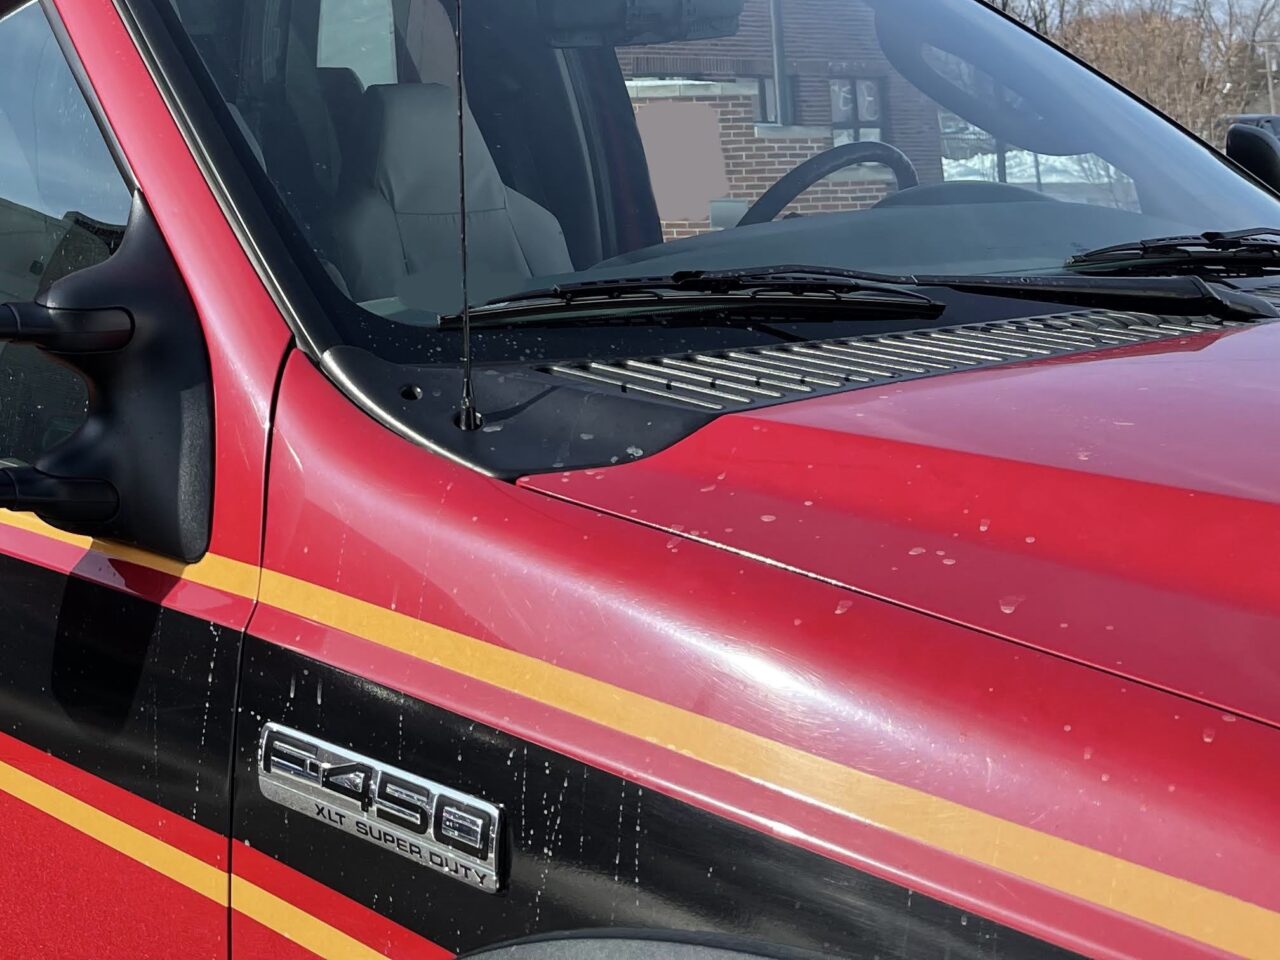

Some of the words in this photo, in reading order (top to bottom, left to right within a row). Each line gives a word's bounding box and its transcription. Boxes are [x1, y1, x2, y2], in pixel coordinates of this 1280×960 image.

[263, 728, 492, 861] F-450
[315, 803, 346, 826] XLT
[355, 820, 423, 859] SUPER
[428, 851, 488, 886] DUTY
